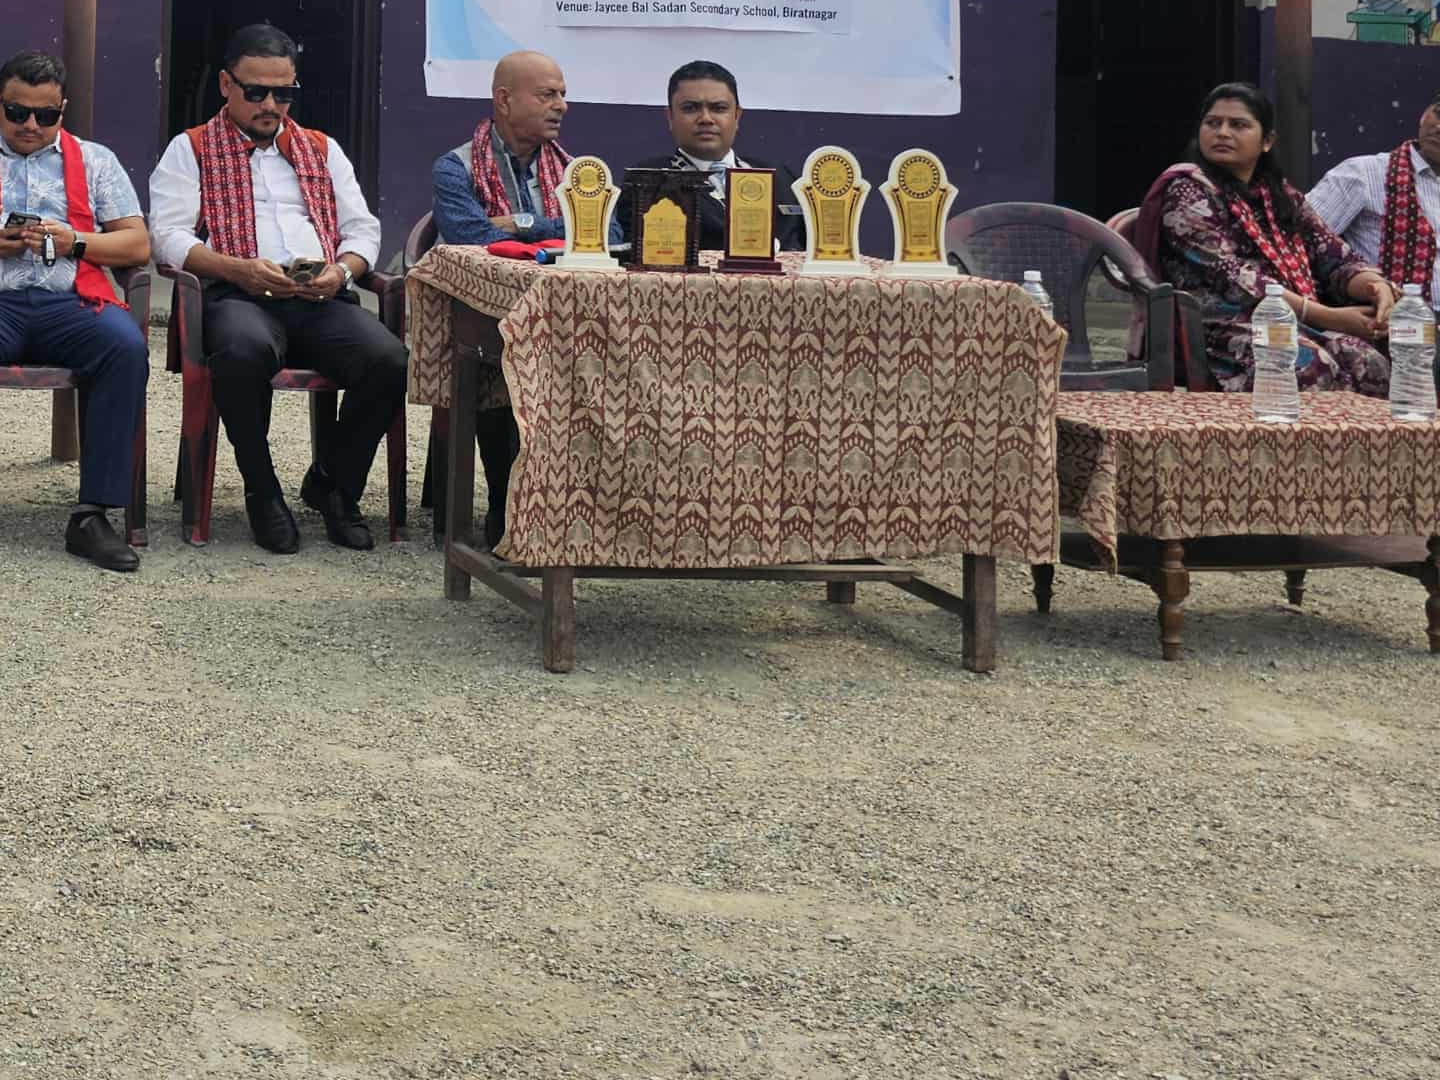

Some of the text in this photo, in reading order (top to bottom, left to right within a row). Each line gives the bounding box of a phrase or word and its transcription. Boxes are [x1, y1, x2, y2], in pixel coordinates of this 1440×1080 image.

[556, 0, 838, 21] Venue: Jaycee Bal Sadan Secondary School, Biratnagar
